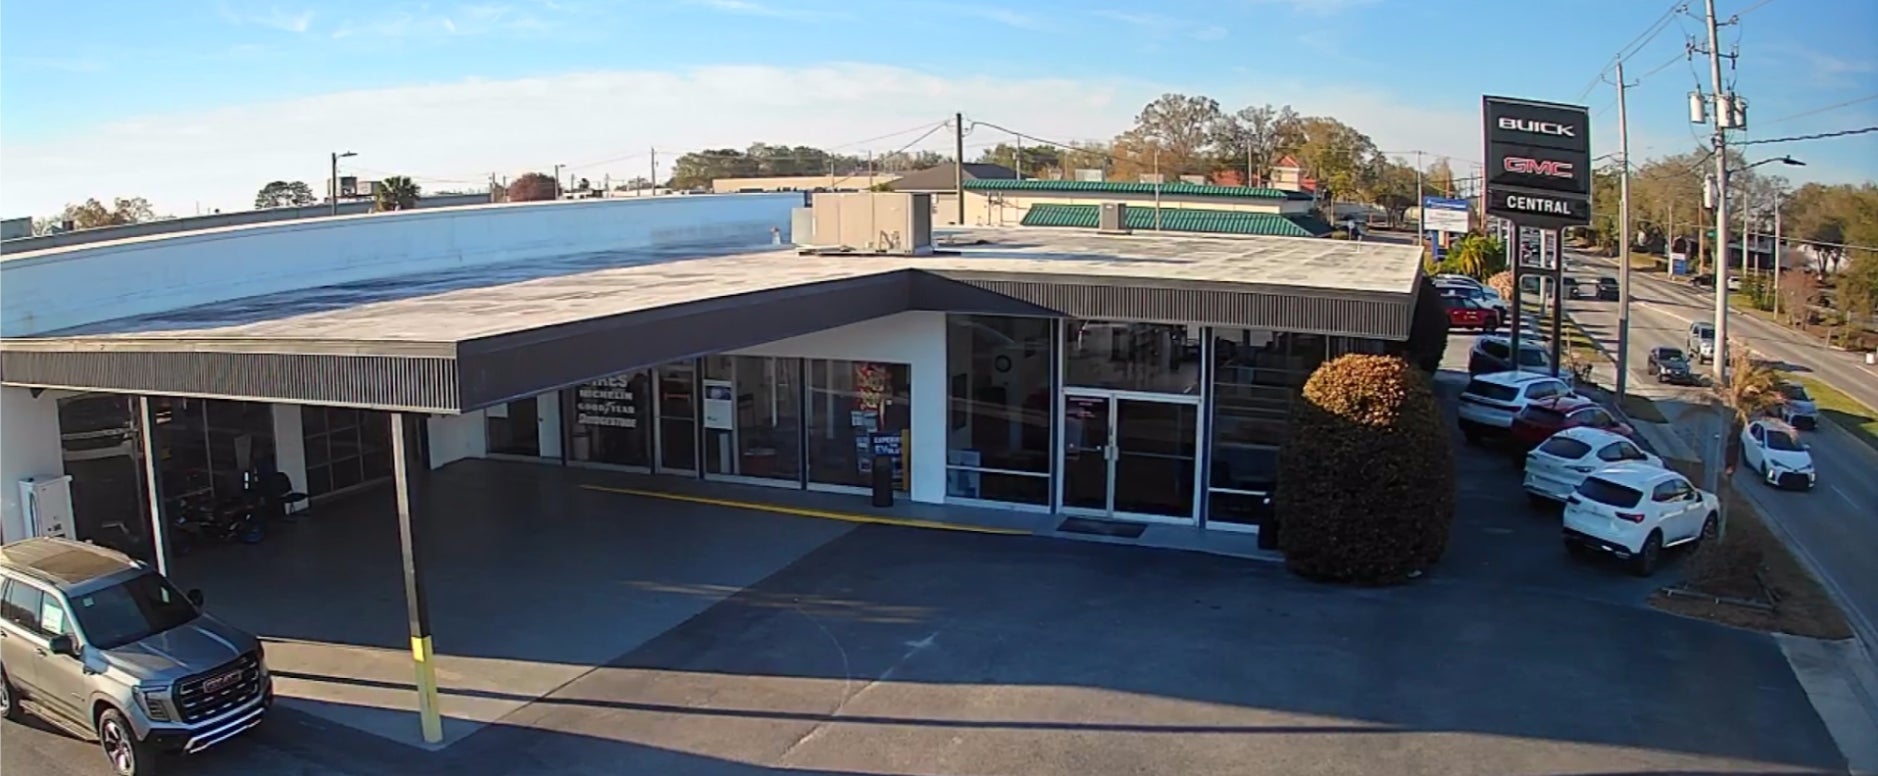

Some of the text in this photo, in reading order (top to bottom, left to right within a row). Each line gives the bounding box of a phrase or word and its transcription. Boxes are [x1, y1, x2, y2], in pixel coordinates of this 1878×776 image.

[1498, 117, 1576, 137] BUICK
[1503, 156, 1573, 178] GMC
[1506, 195, 1571, 215] CENTRAL
